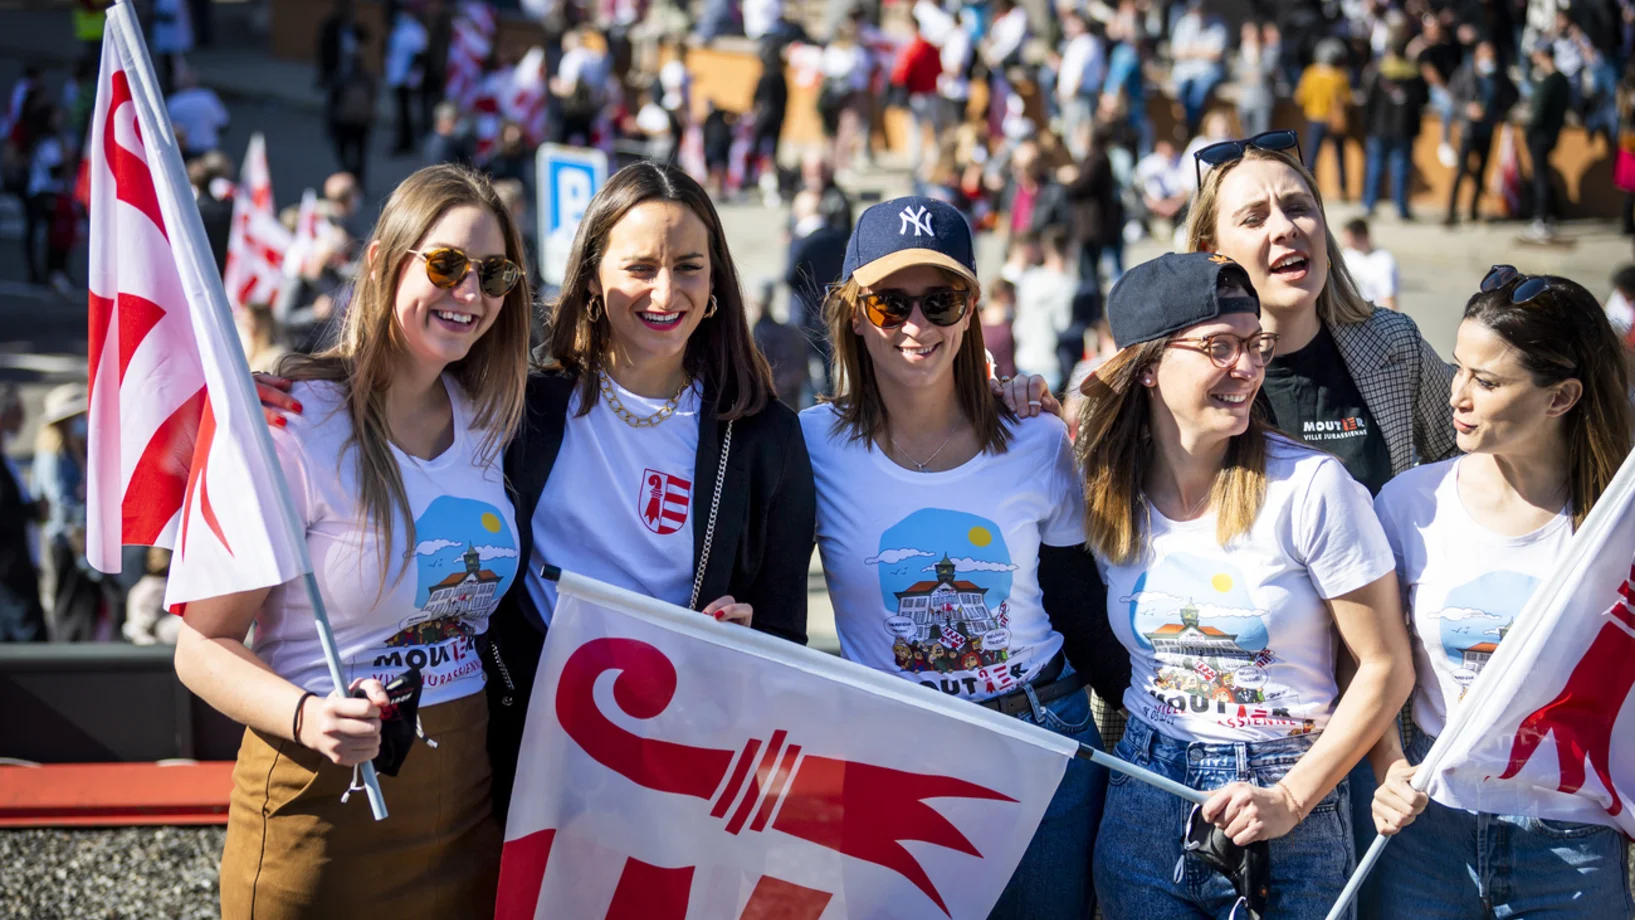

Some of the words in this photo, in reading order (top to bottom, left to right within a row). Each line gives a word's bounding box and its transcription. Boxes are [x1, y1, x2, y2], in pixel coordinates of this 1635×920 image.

[899, 205, 935, 237] NY
[1303, 417, 1365, 431] MOUTIER
[1324, 429, 1367, 440] JURASSIENNE
[919, 662, 1029, 695] UTIER
